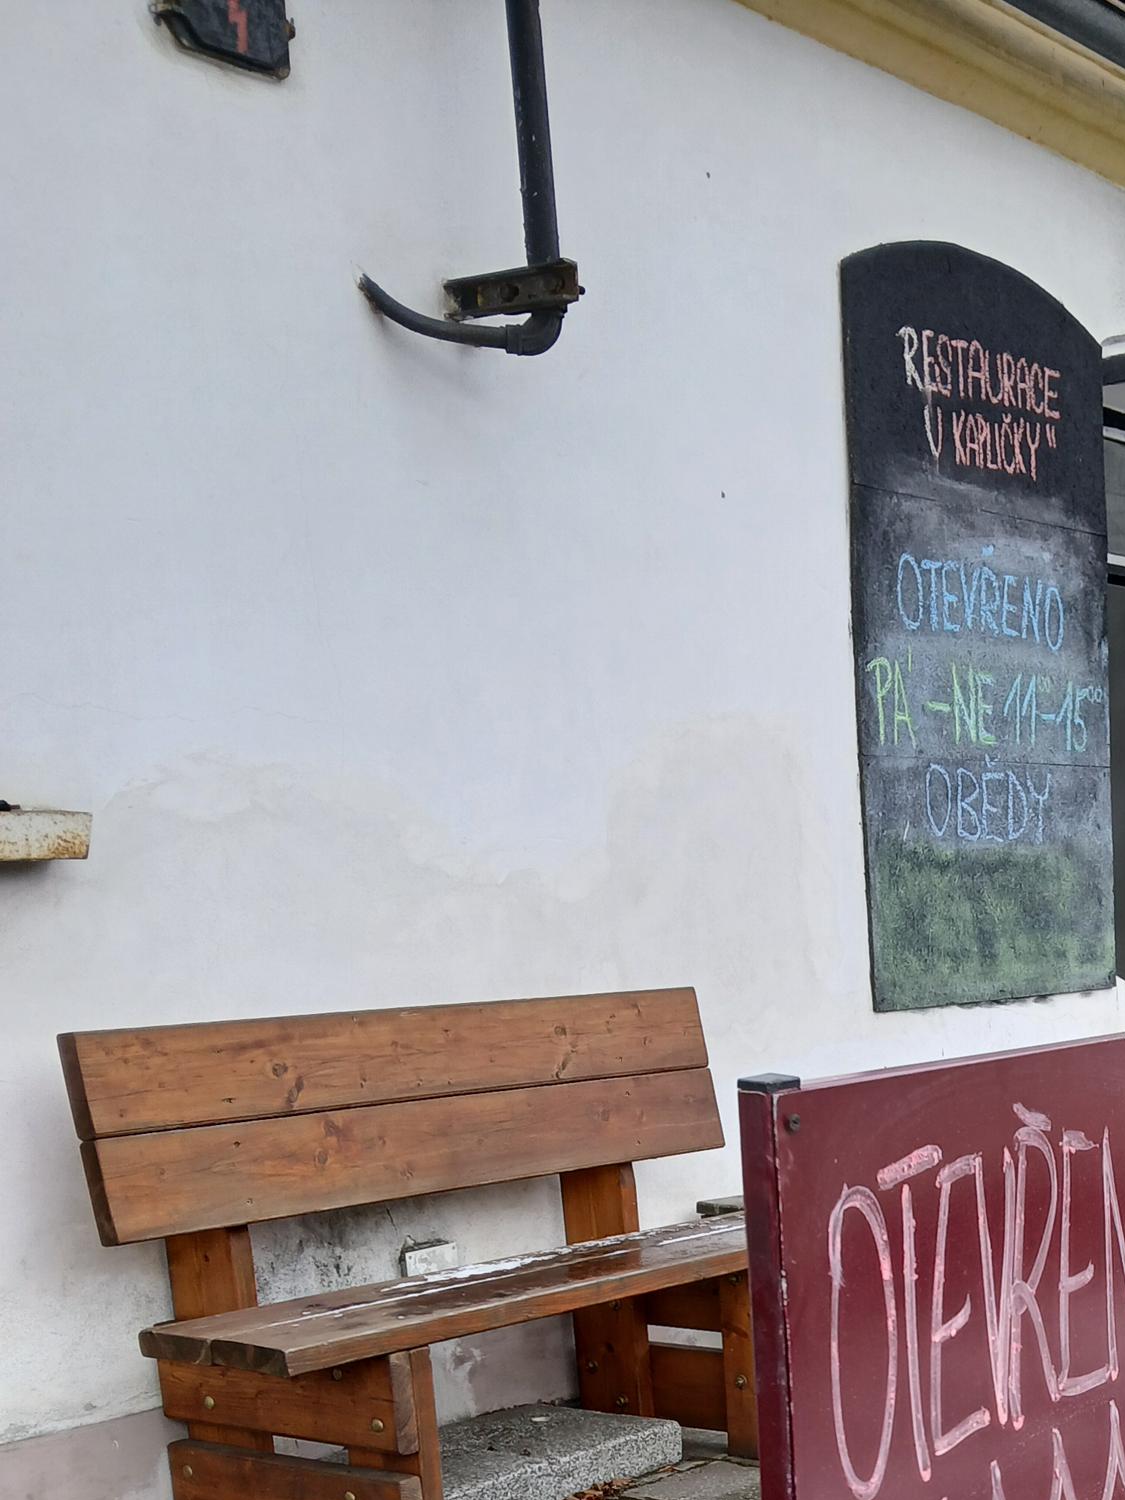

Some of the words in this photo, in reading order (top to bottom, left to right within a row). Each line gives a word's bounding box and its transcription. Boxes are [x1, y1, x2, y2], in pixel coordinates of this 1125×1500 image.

[896, 326, 1060, 419] RESTAURACE
[897, 544, 1064, 652] OTEVŘENO
[926, 754, 1051, 844] OBĚDY
